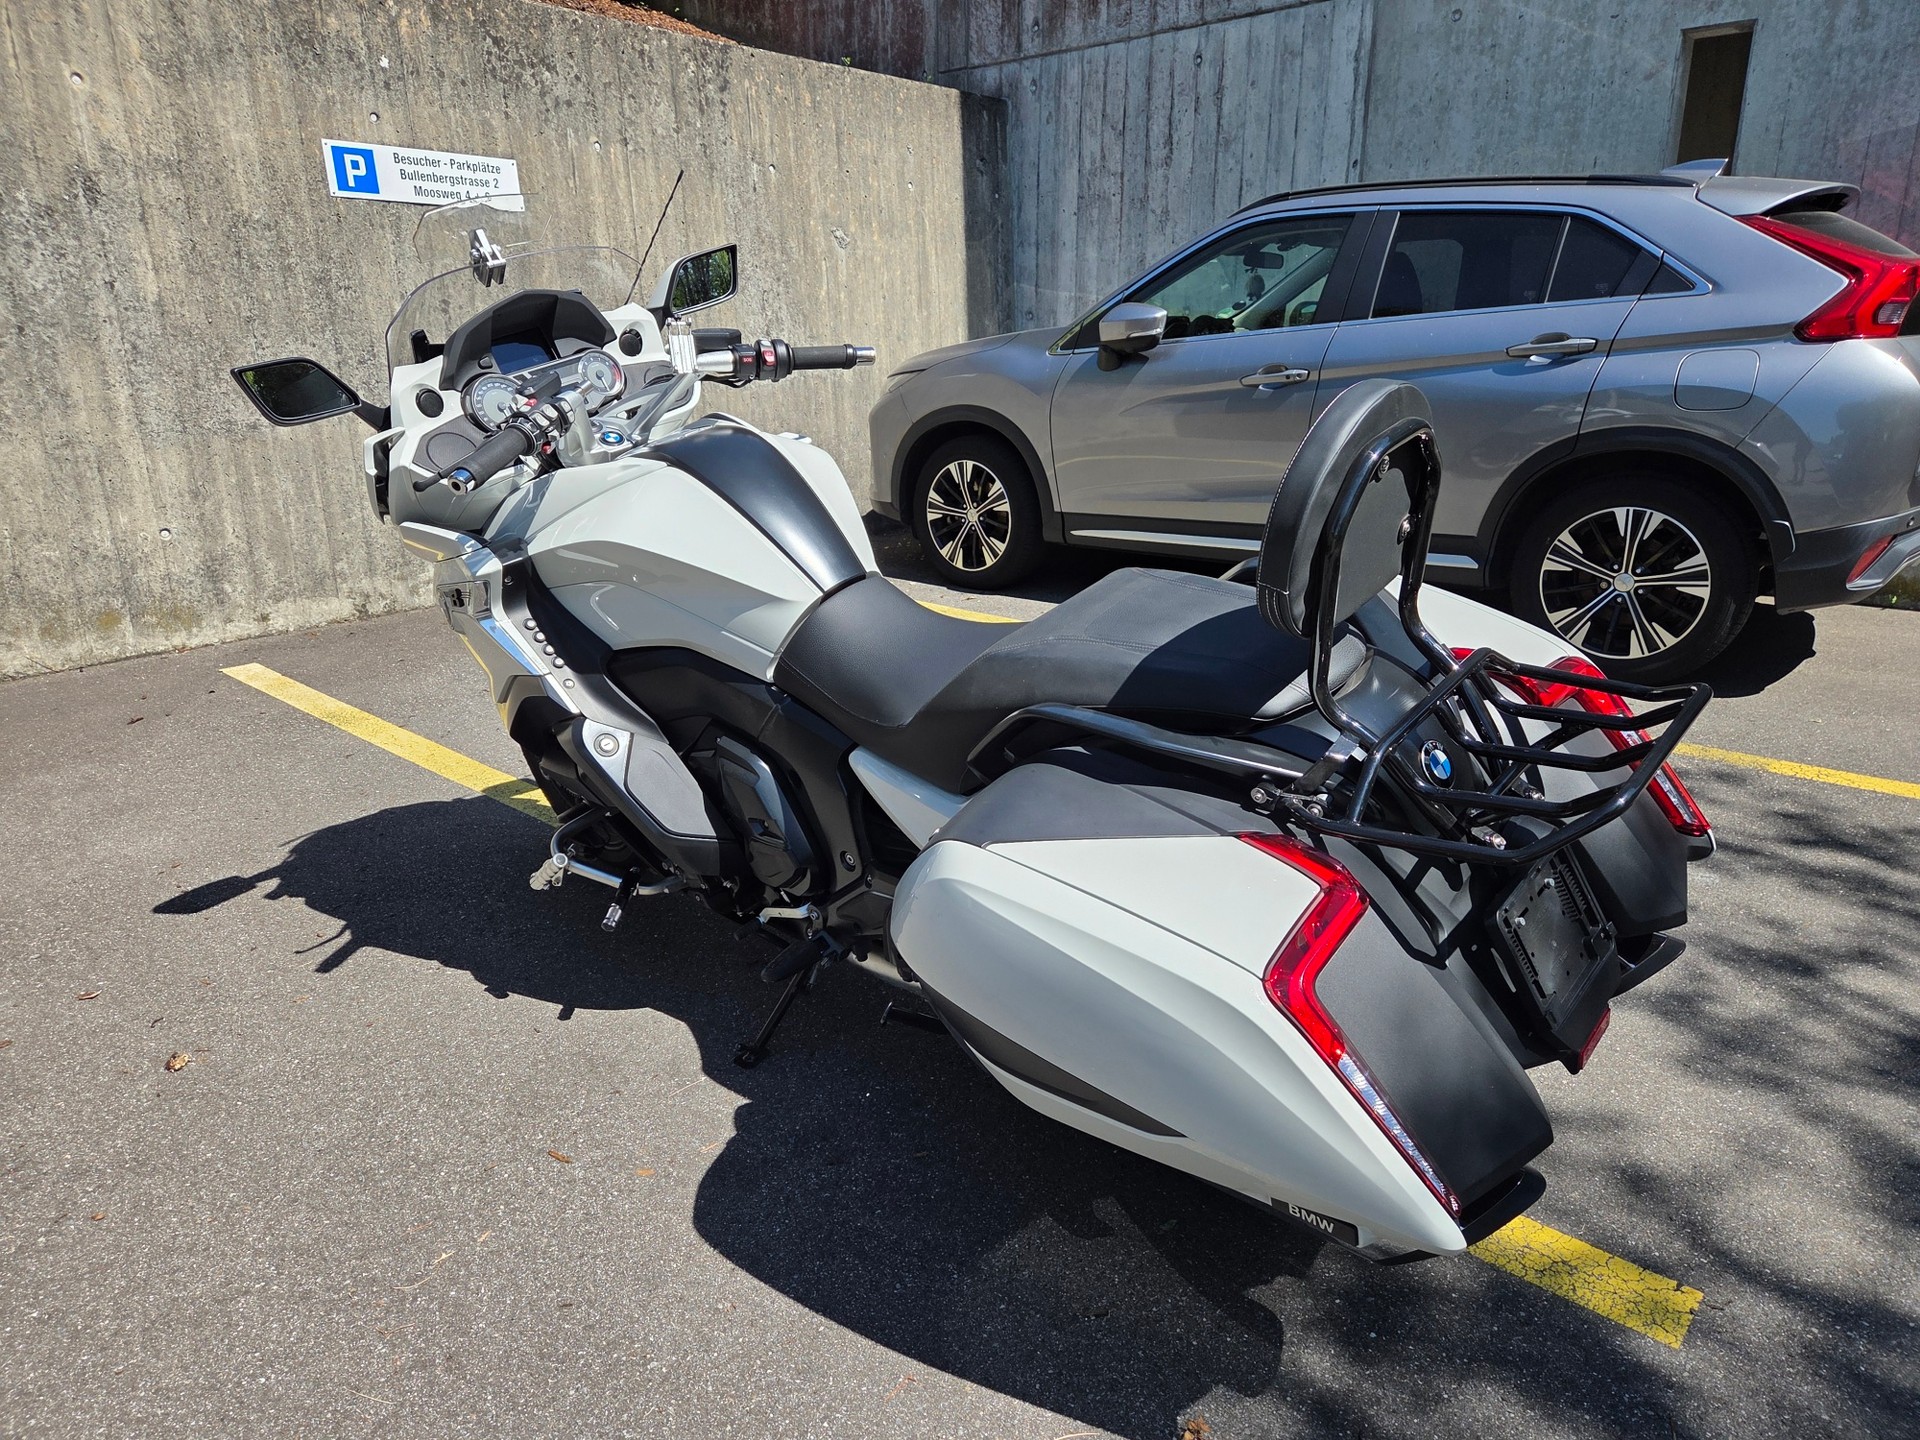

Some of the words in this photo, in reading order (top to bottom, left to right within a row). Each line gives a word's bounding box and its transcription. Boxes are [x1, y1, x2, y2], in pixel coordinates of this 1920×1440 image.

[343, 153, 367, 188] P
[393, 152, 441, 168] Besucher
[449, 158, 501, 175] Parkplätze
[399, 168, 491, 188] Bullenbergstrasse
[492, 178, 500, 189] 2
[413, 185, 462, 201] Moosweg
[464, 190, 472, 200] 4
[1289, 1203, 1334, 1233] BMW
